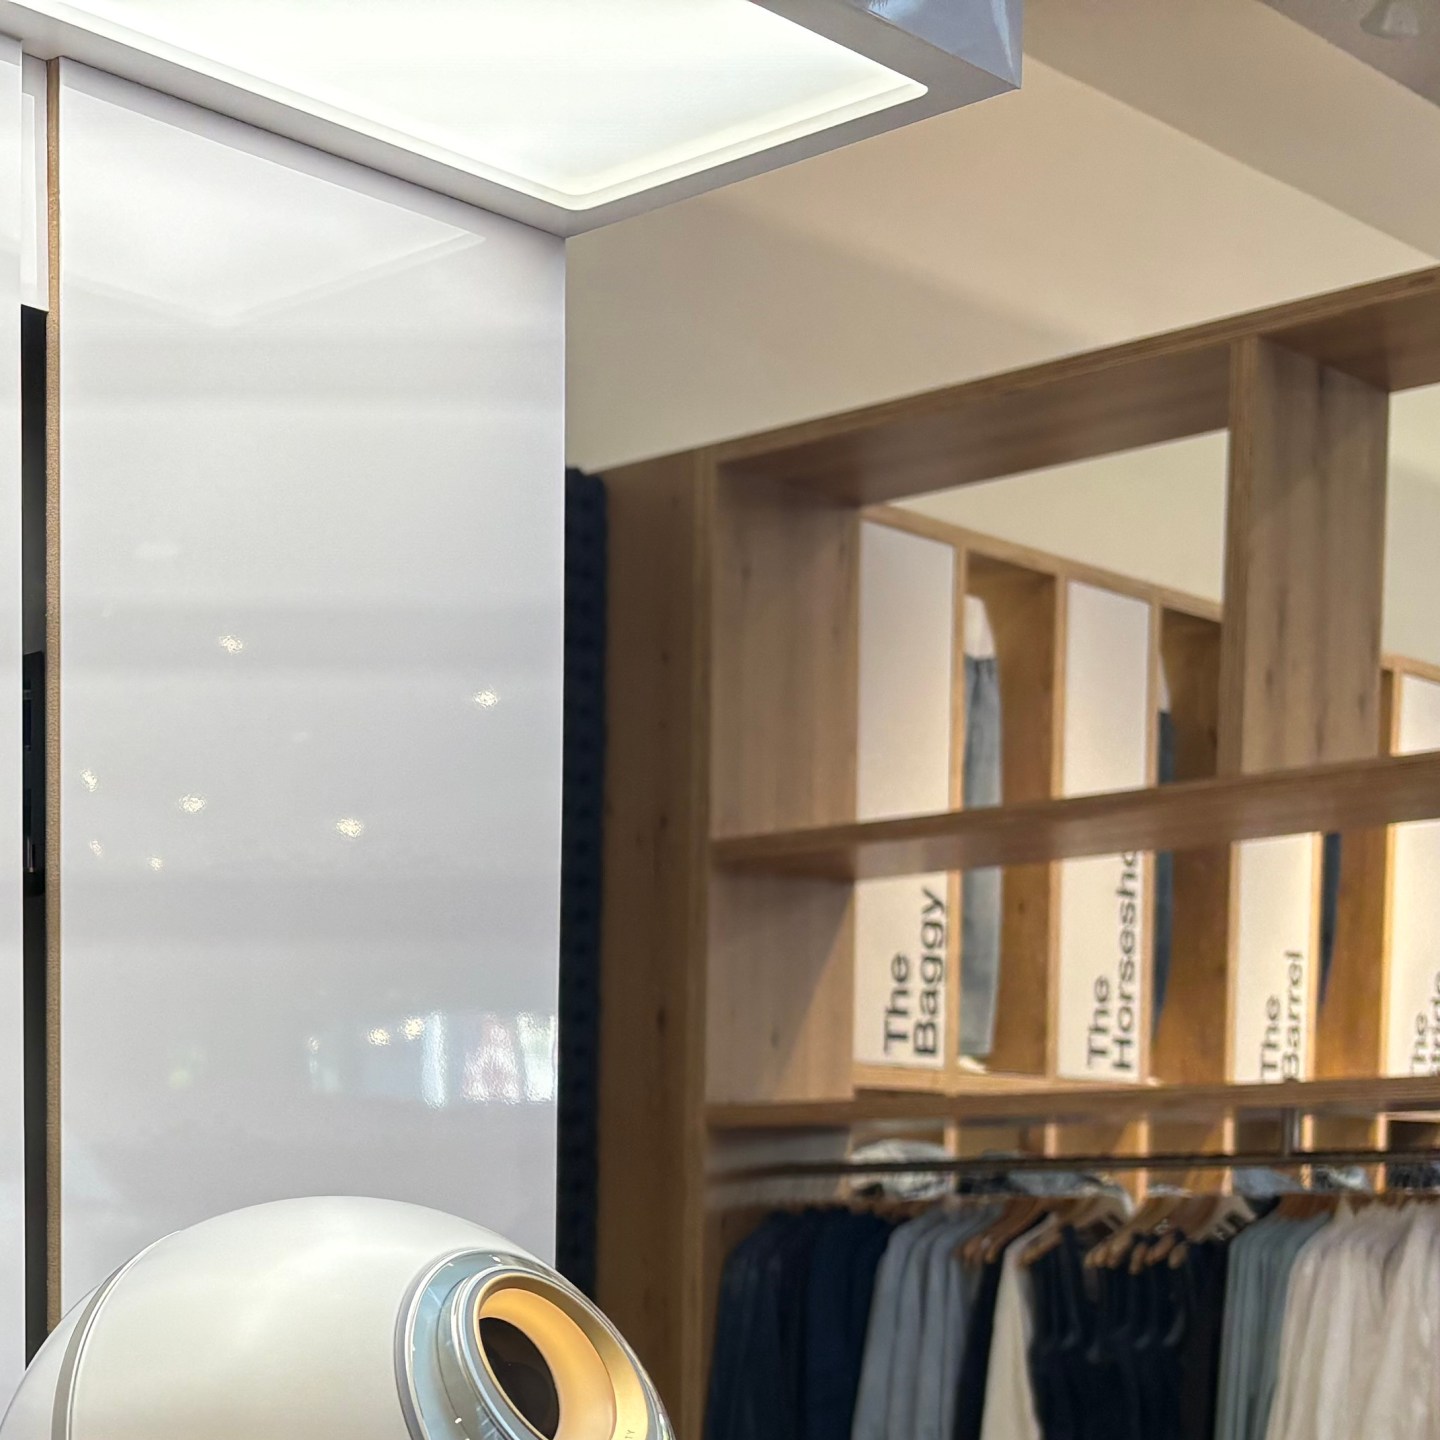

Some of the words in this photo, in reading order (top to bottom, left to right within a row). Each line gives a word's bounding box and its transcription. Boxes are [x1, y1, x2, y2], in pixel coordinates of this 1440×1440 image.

[883, 951, 910, 1057] The
[913, 886, 946, 1057] Baggy
[1086, 974, 1111, 1070] The
[1282, 950, 1304, 1083] Barrel
[1260, 994, 1282, 1084] The
